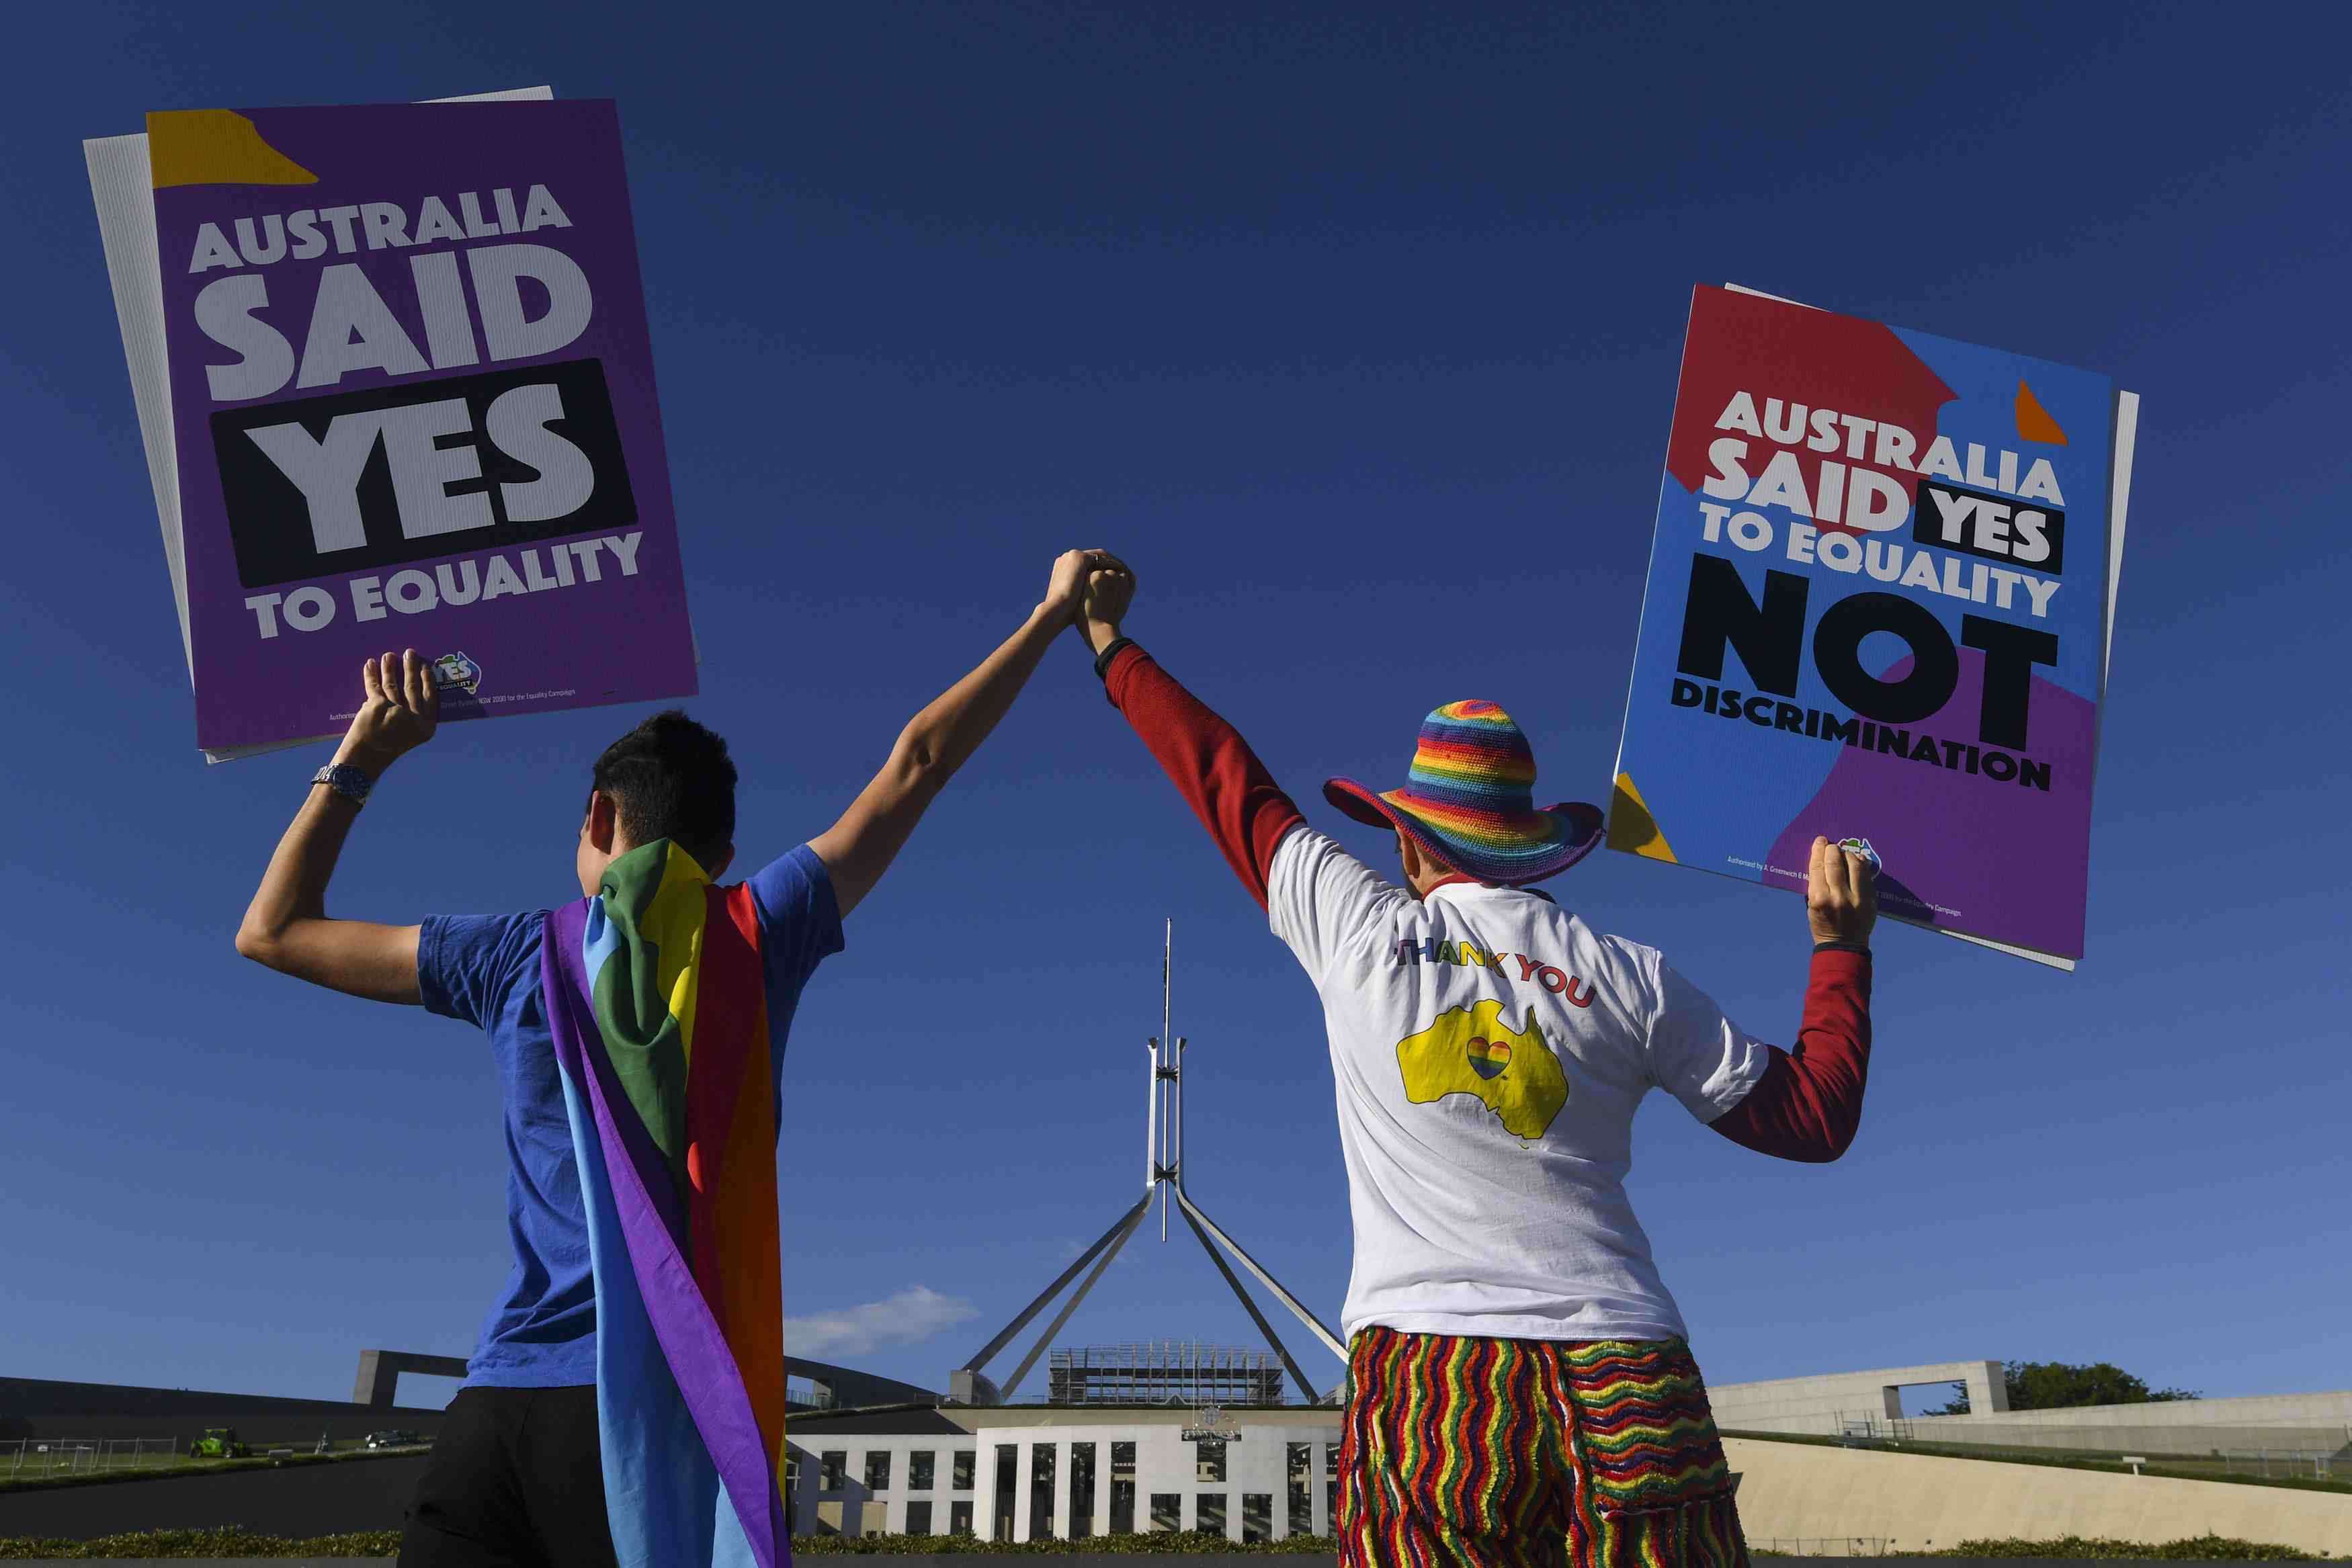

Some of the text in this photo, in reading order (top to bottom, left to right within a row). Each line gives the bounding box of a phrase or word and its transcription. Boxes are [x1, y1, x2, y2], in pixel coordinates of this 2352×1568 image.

[188, 184, 573, 273] AUSTRALIA
[194, 243, 593, 401] SAID
[243, 383, 595, 554] YES
[1703, 437, 2051, 563] SAID YES
[1714, 390, 2065, 507] AUSTRALIA
[245, 531, 643, 639] TO EQUALITY
[1698, 502, 2060, 618] TO EQUALITY
[435, 660, 472, 683] YES
[478, 697, 491, 705] NSW
[526, 691, 547, 700] Equality
[548, 689, 575, 697] Campaign
[1677, 552, 2058, 752] NOT
[1670, 677, 2051, 792] DISCRIMINATION
[1727, 856, 1755, 868] Authorised
[1770, 866, 1797, 877] Greenwich
[1935, 904, 1962, 916] Campaign
[1394, 937, 1597, 1008] THANK YOU
